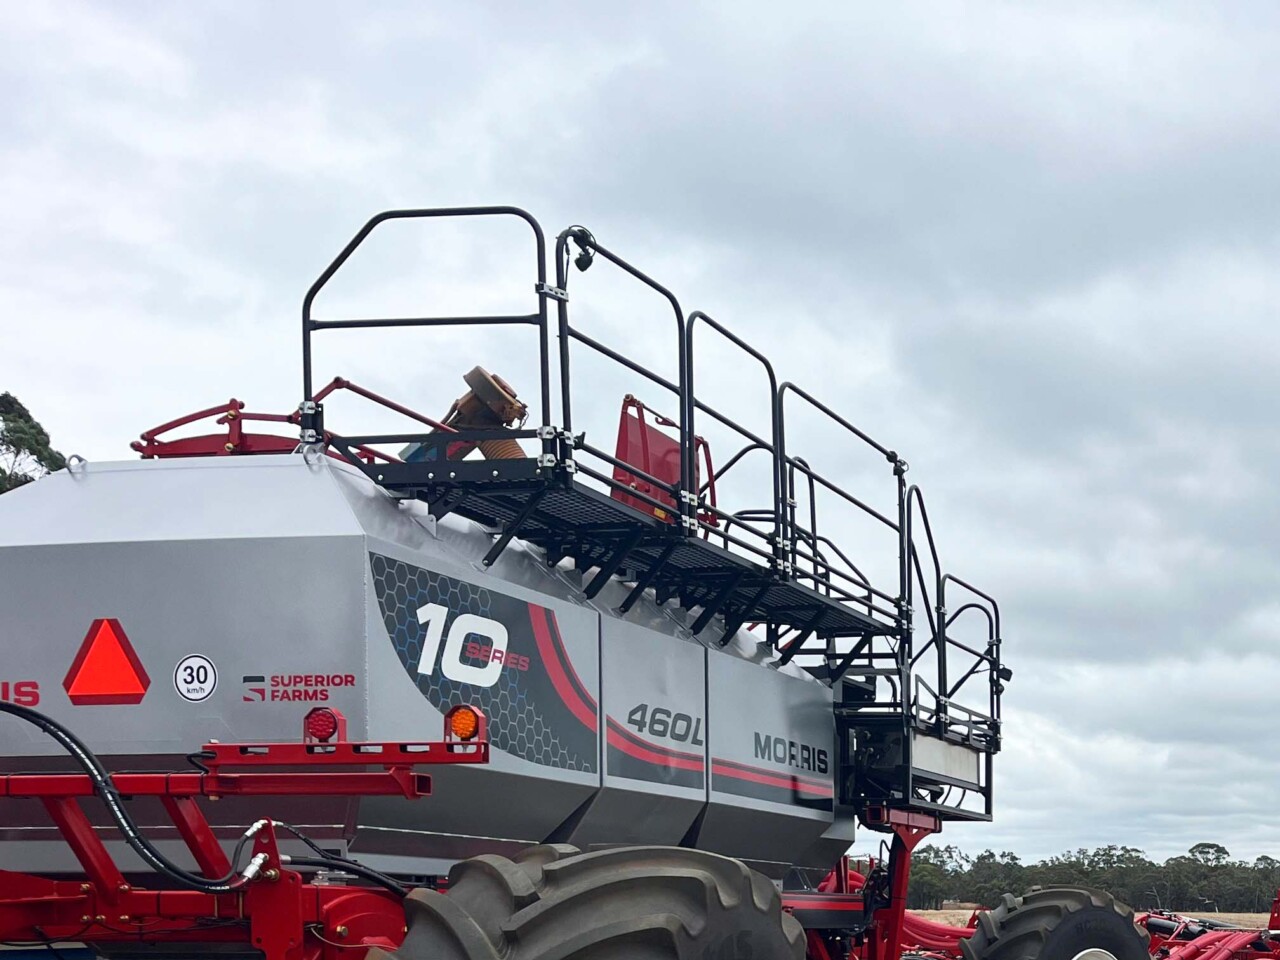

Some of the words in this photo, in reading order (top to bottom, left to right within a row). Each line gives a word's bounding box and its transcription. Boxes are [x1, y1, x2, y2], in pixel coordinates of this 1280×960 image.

[416, 602, 509, 688] 10
[465, 641, 530, 672] SERIES
[183, 665, 208, 684] 30
[270, 674, 355, 687] SUPERIOR
[187, 686, 206, 694] km/h
[270, 689, 329, 702] FARMS
[627, 703, 704, 746] 460L
[753, 731, 829, 774] MORRIS
